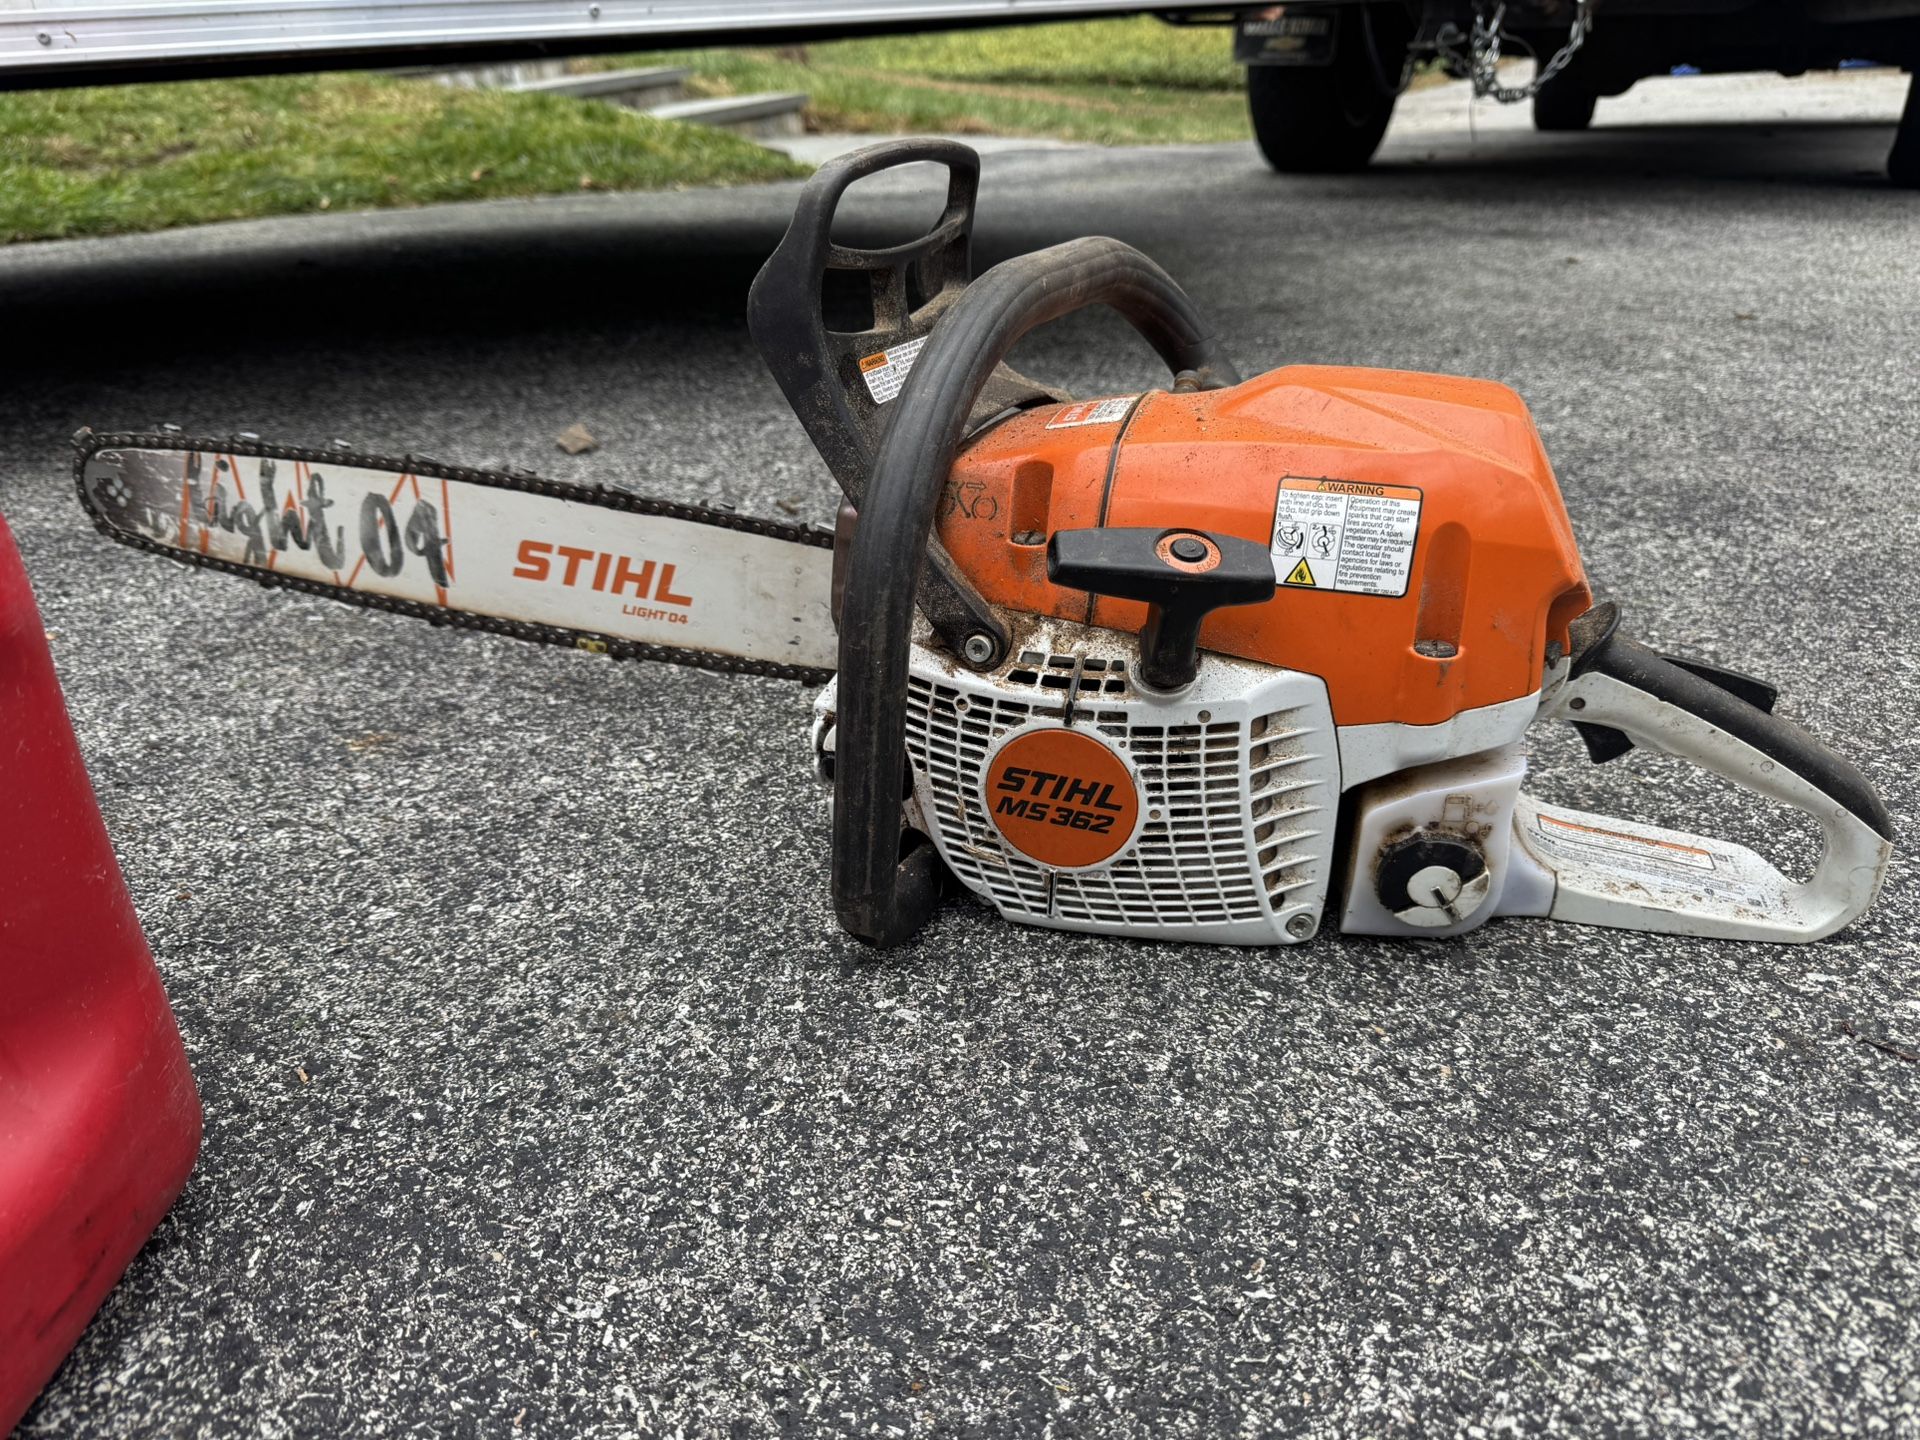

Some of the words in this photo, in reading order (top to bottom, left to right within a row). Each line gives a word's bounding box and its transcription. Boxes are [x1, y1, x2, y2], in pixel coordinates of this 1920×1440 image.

[1327, 482, 1384, 496] WARNING
[1282, 490, 1288, 498] To
[1290, 492, 1310, 502] tighten
[1350, 496, 1380, 505] Operation
[1382, 498, 1389, 506] of
[1389, 499, 1401, 507] this
[1311, 509, 1323, 517] grip
[1324, 509, 1340, 517] down
[1349, 504, 1381, 513] equipment
[1348, 511, 1369, 519] sparks
[1361, 520, 1383, 528] around
[1384, 522, 1395, 530] dry
[1345, 526, 1379, 535] vegetation.
[1386, 530, 1403, 538] spark
[1344, 540, 1355, 548] The
[1356, 543, 1382, 551] operator
[1384, 545, 1405, 553] should
[1342, 549, 1365, 557] contact
[512, 539, 693, 607] STIHL
[1340, 564, 1373, 572] regulations
[1374, 567, 1397, 576] relating
[1349, 572, 1382, 580] prevention
[1337, 578, 1378, 587] requirements.
[622, 604, 667, 621] LIGHT
[997, 766, 1123, 812] STIHL
[996, 796, 1050, 822] MS
[1050, 806, 1116, 835] 362
